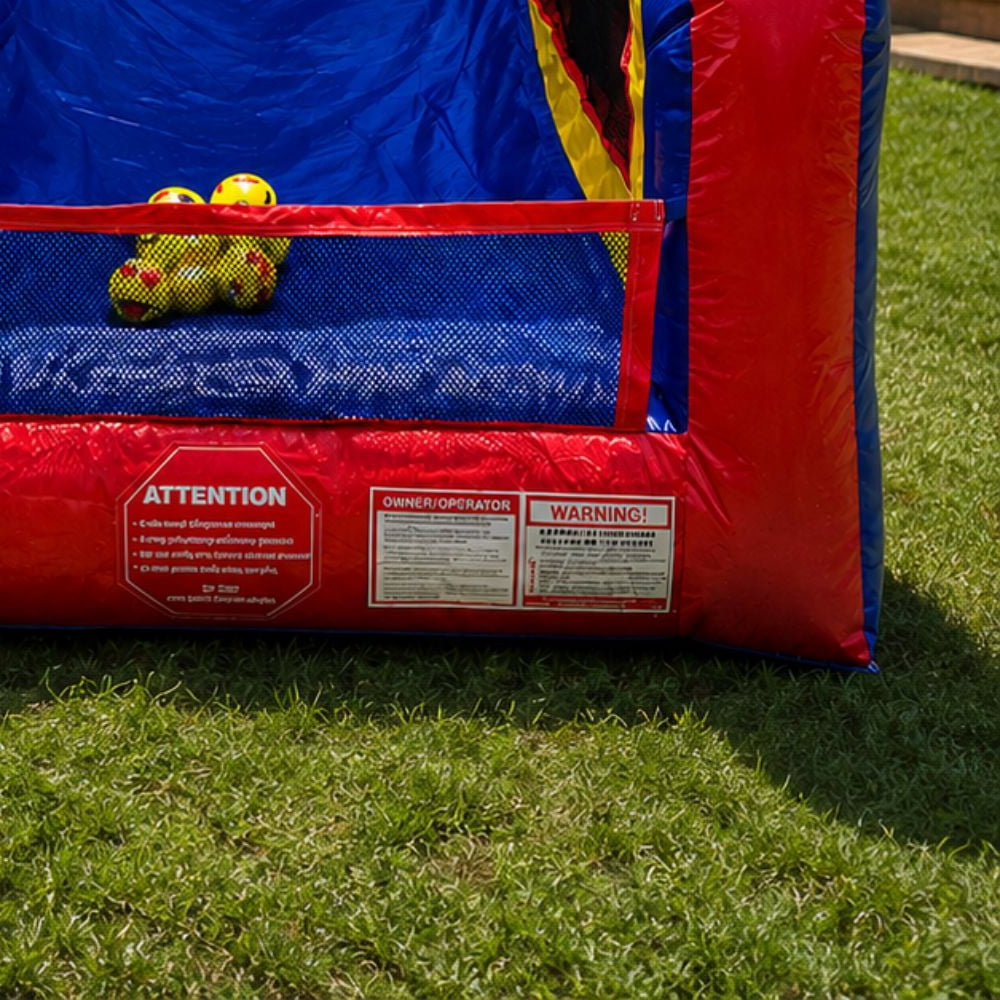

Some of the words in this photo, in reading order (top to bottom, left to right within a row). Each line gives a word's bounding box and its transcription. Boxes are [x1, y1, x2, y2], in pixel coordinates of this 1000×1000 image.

[142, 485, 287, 507] ATTENTION
[383, 496, 511, 511] OWNER/OPERATOR
[551, 504, 647, 523] WARNING!
